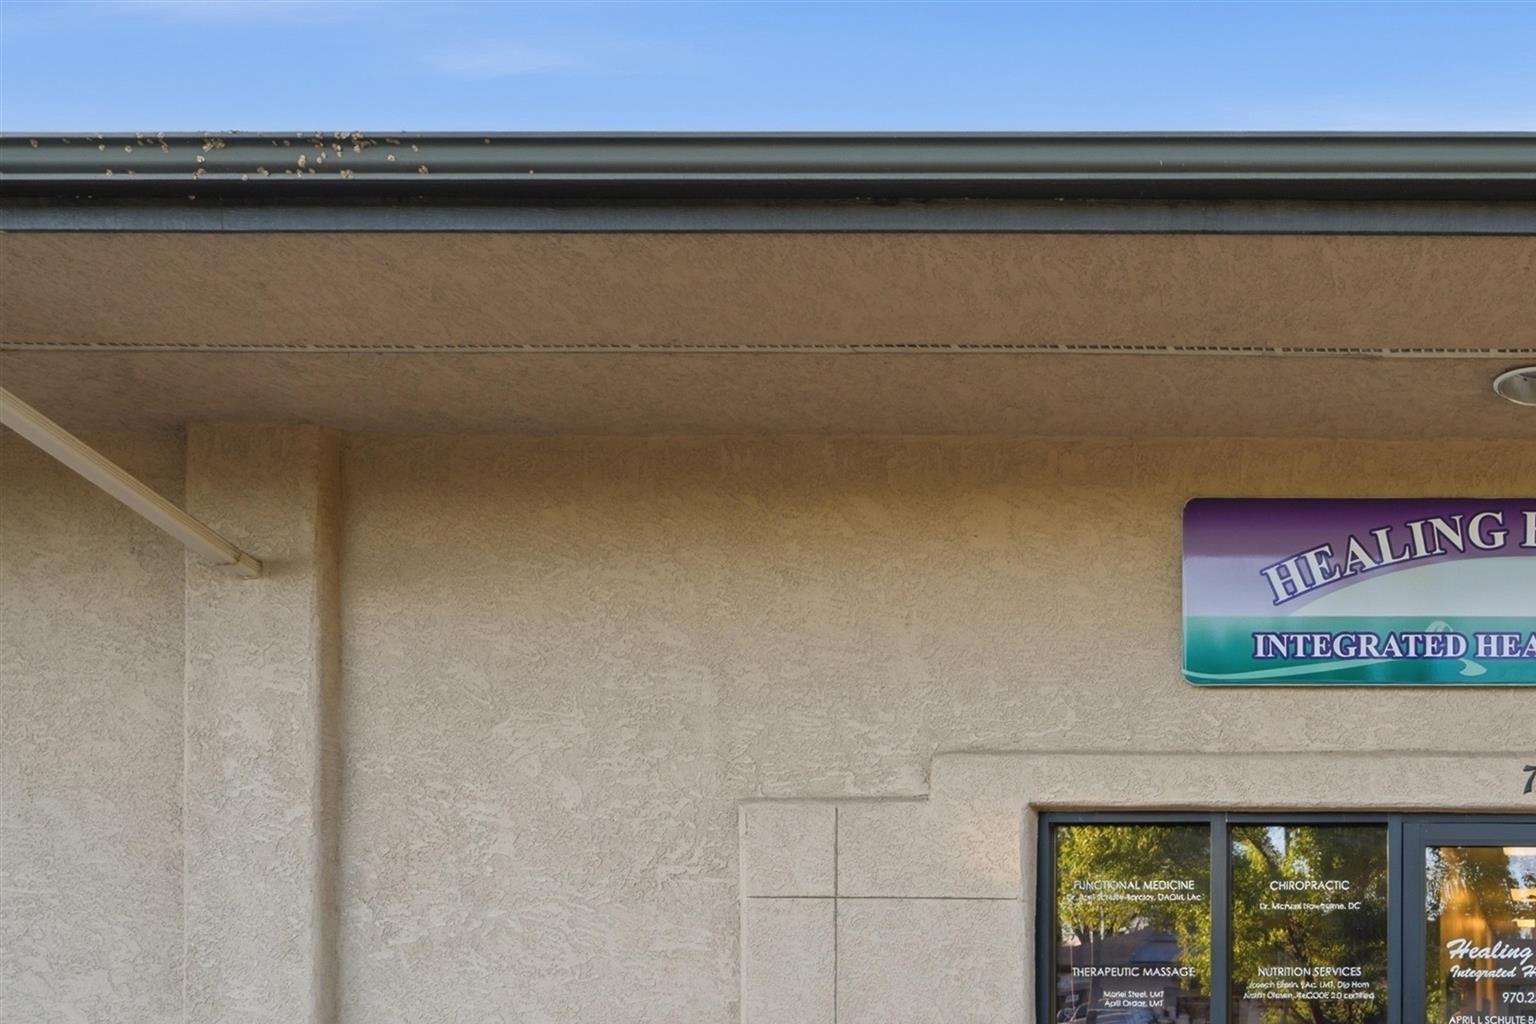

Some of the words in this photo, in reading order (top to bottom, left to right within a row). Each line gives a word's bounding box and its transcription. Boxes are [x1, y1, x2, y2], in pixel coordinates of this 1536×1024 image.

[1260, 510, 1507, 605] HEALING
[1254, 632, 1468, 660] INTEGRATED
[1074, 880, 1140, 890] FUNCTIONAL
[1143, 880, 1194, 890] MEDICINE
[1270, 880, 1350, 890] CHIROPRACTIC
[1260, 902, 1270, 910] Dr.
[1348, 902, 1360, 910] DC
[1447, 938, 1533, 965] Healing
[1072, 967, 1139, 976] THERAPEUTIC
[1143, 967, 1196, 976] MASSAGE
[1258, 967, 1310, 976] NUTRITION
[1313, 967, 1362, 976] SERVICES
[1450, 965, 1516, 981] Integrated
[1352, 980, 1369, 988] Hom
[1449, 1016, 1475, 1024] APRIL
